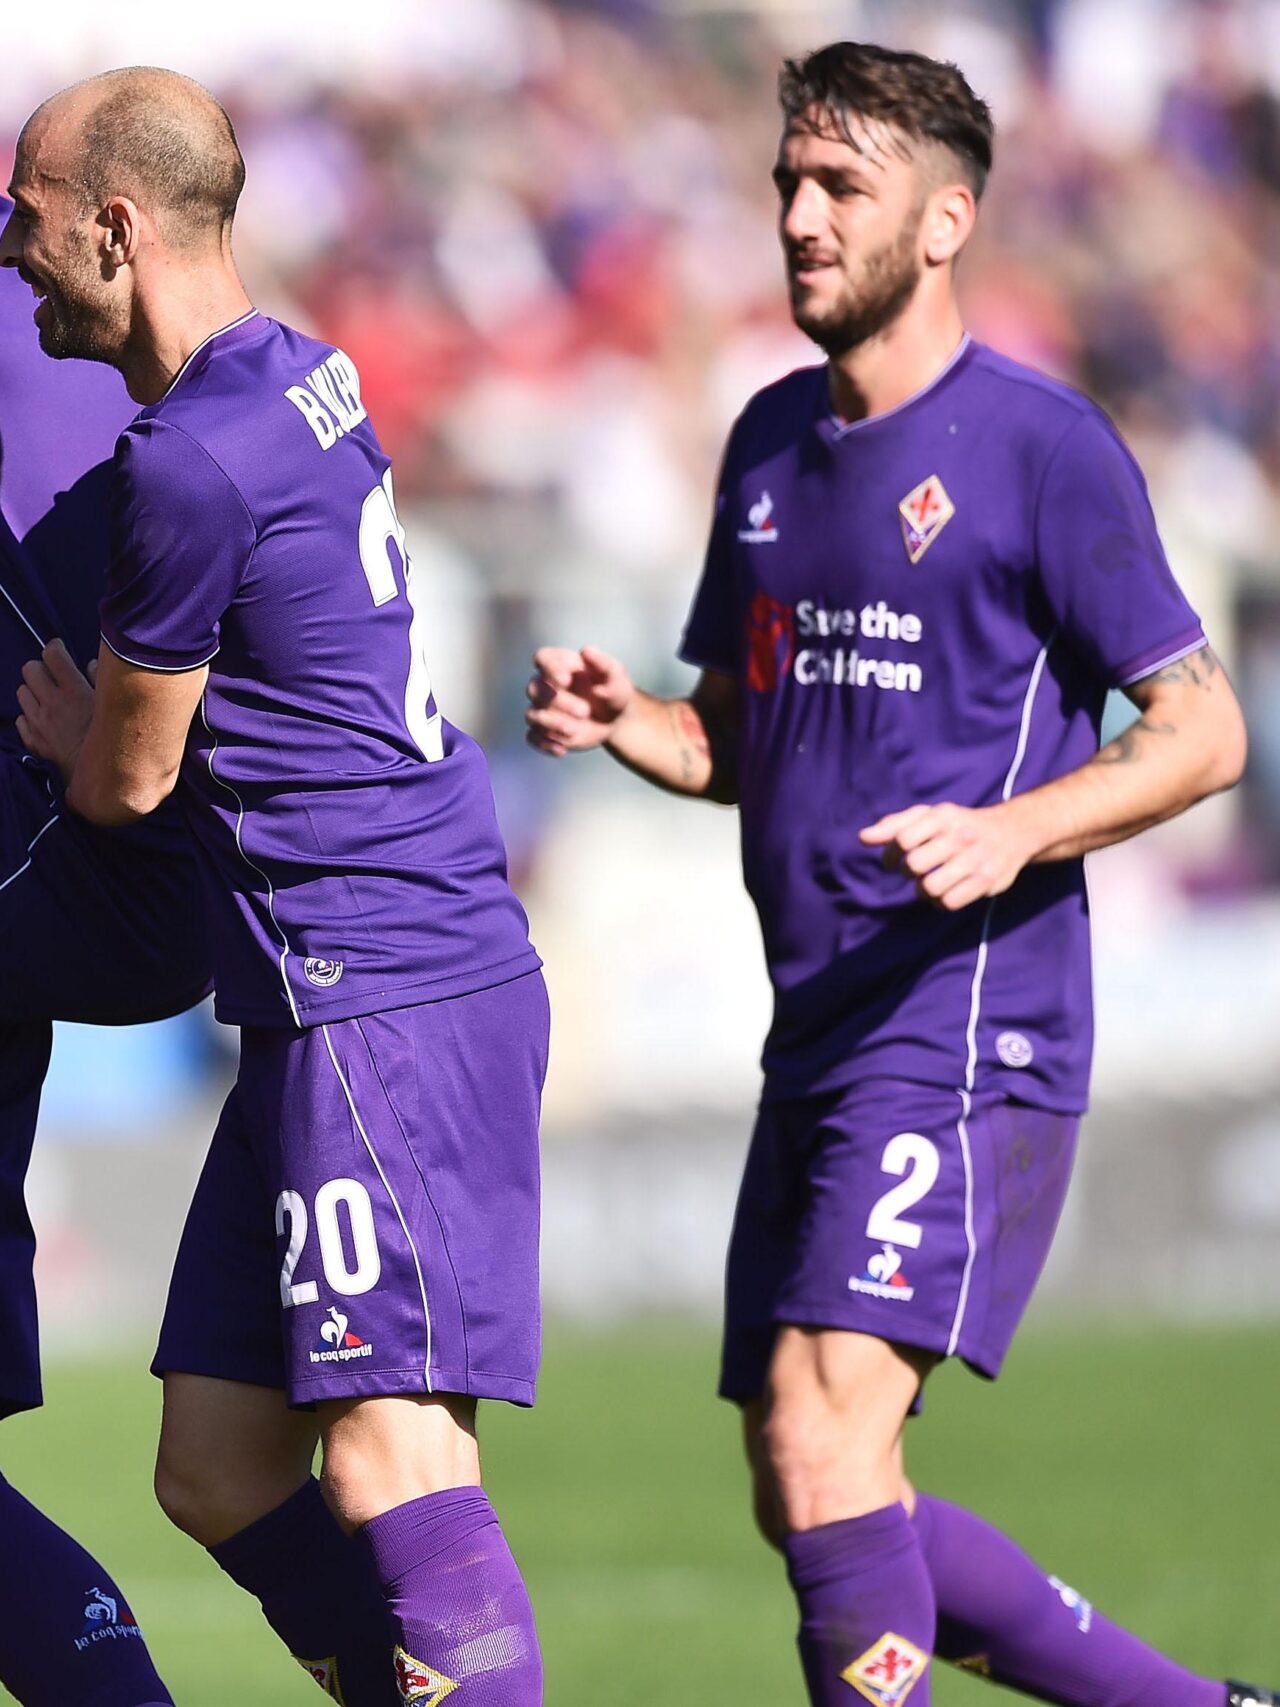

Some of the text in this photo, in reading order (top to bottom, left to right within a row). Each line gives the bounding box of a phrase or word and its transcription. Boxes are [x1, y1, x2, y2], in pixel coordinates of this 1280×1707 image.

[860, 600, 923, 642] the
[865, 1132, 941, 1250] 2
[275, 1177, 382, 1310] 20
[309, 1343, 373, 1363] le coq sportif
